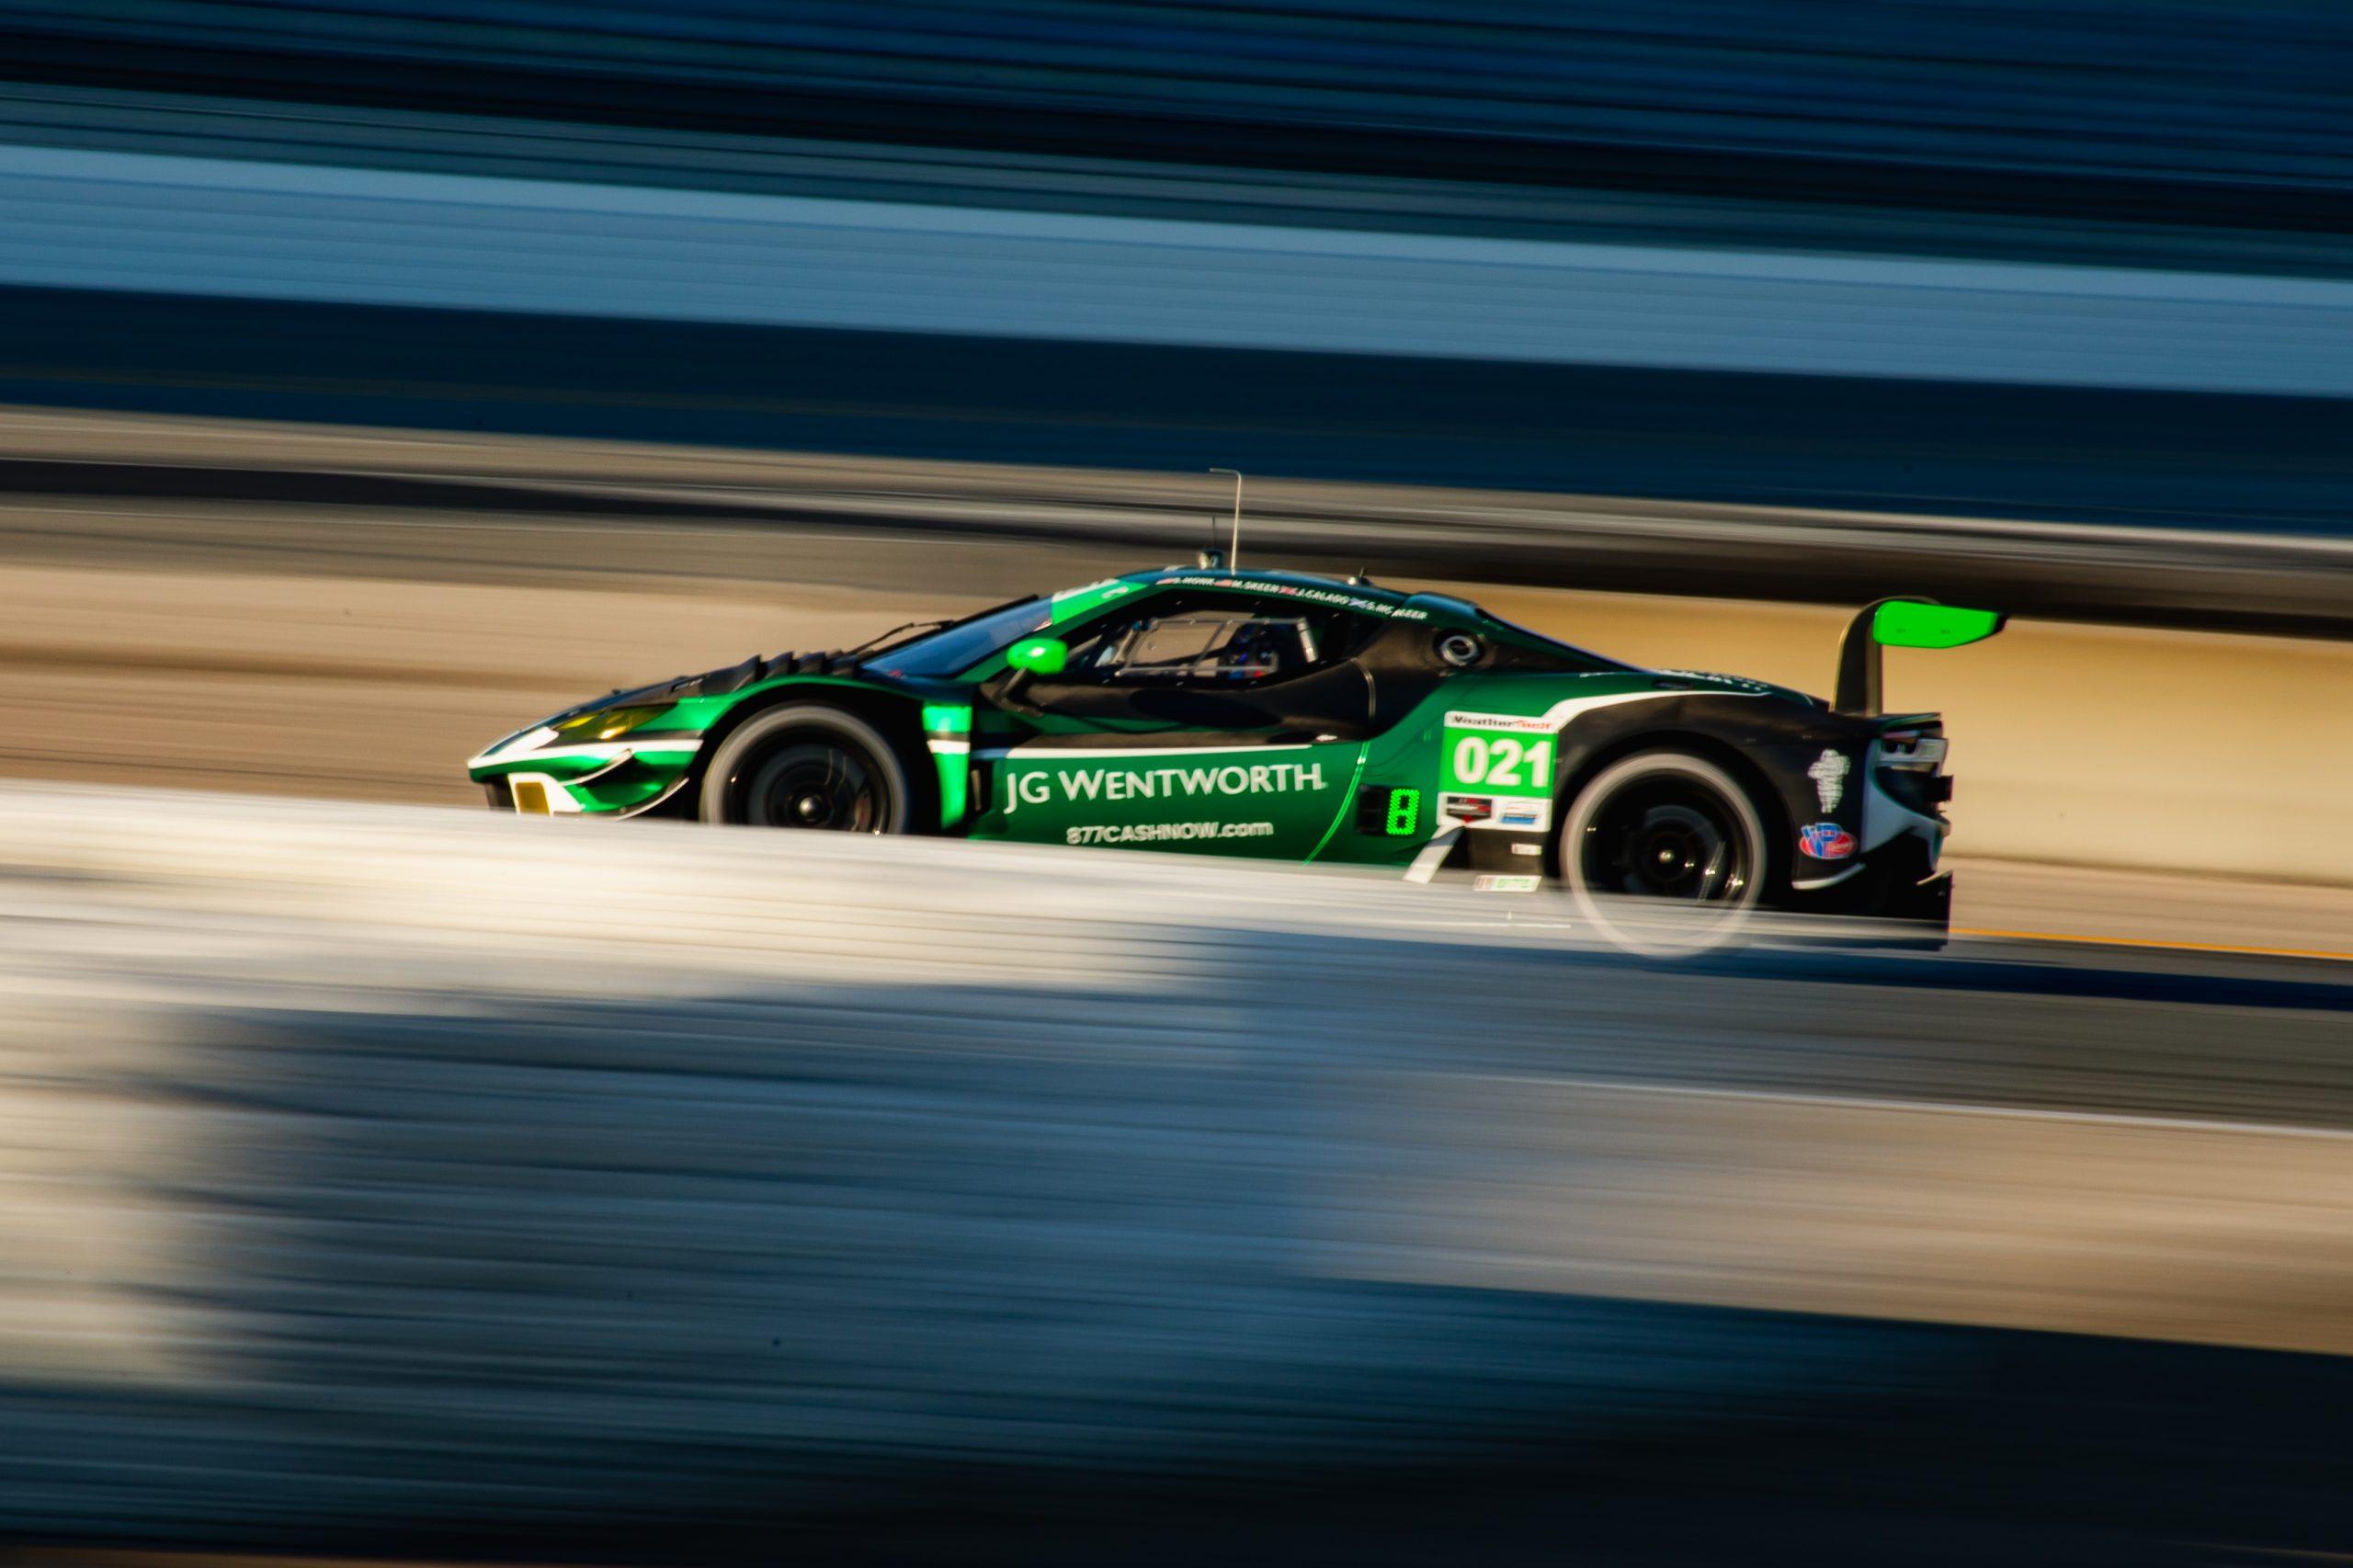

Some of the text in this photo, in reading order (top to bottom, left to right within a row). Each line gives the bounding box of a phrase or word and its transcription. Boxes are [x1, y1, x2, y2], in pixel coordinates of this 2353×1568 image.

[1453, 736, 1552, 788] 021
[1004, 763, 1323, 814] JG WENTWORTH
[1386, 789, 1420, 835] 8
[1066, 822, 1274, 845] 877CASHNOW.com
